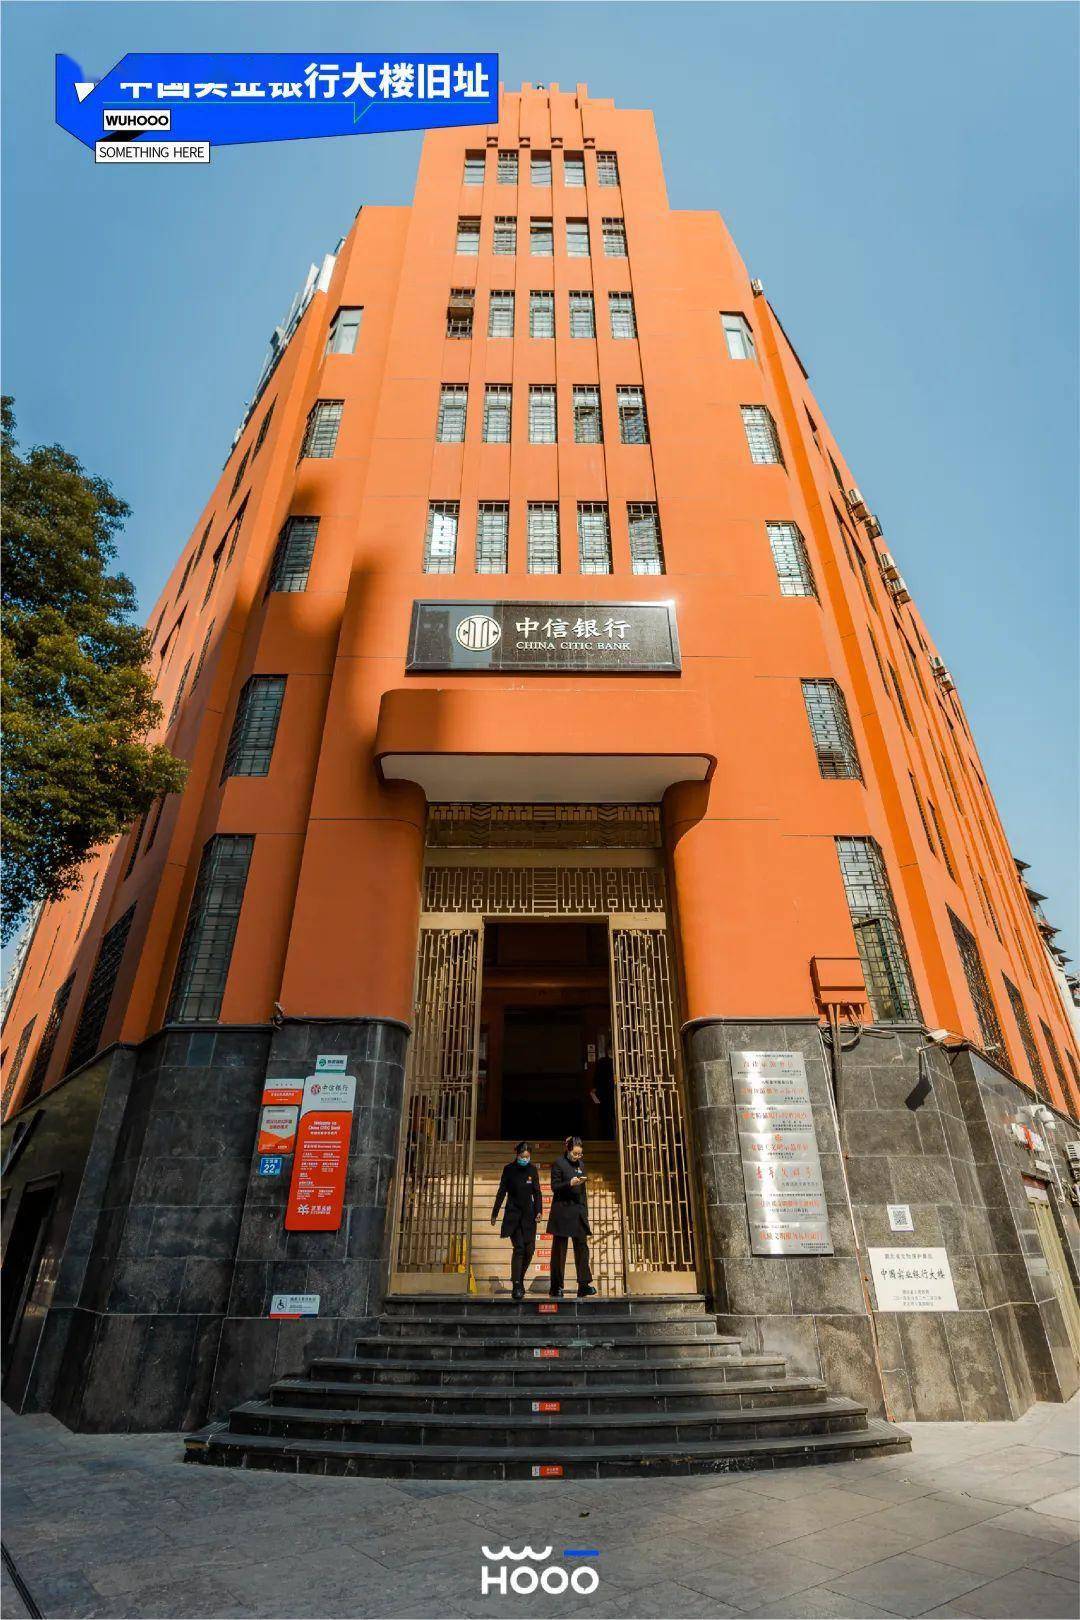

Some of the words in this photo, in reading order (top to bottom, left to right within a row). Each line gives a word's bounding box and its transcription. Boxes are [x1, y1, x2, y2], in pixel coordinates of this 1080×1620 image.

[515, 617, 632, 639] 中信银行
[516, 641, 556, 651] CHINA
[560, 641, 593, 651] CITIC
[597, 641, 631, 651] BANK
[263, 1163, 276, 1174] 22
[880, 1268, 946, 1281] 中国实业银行大楼
